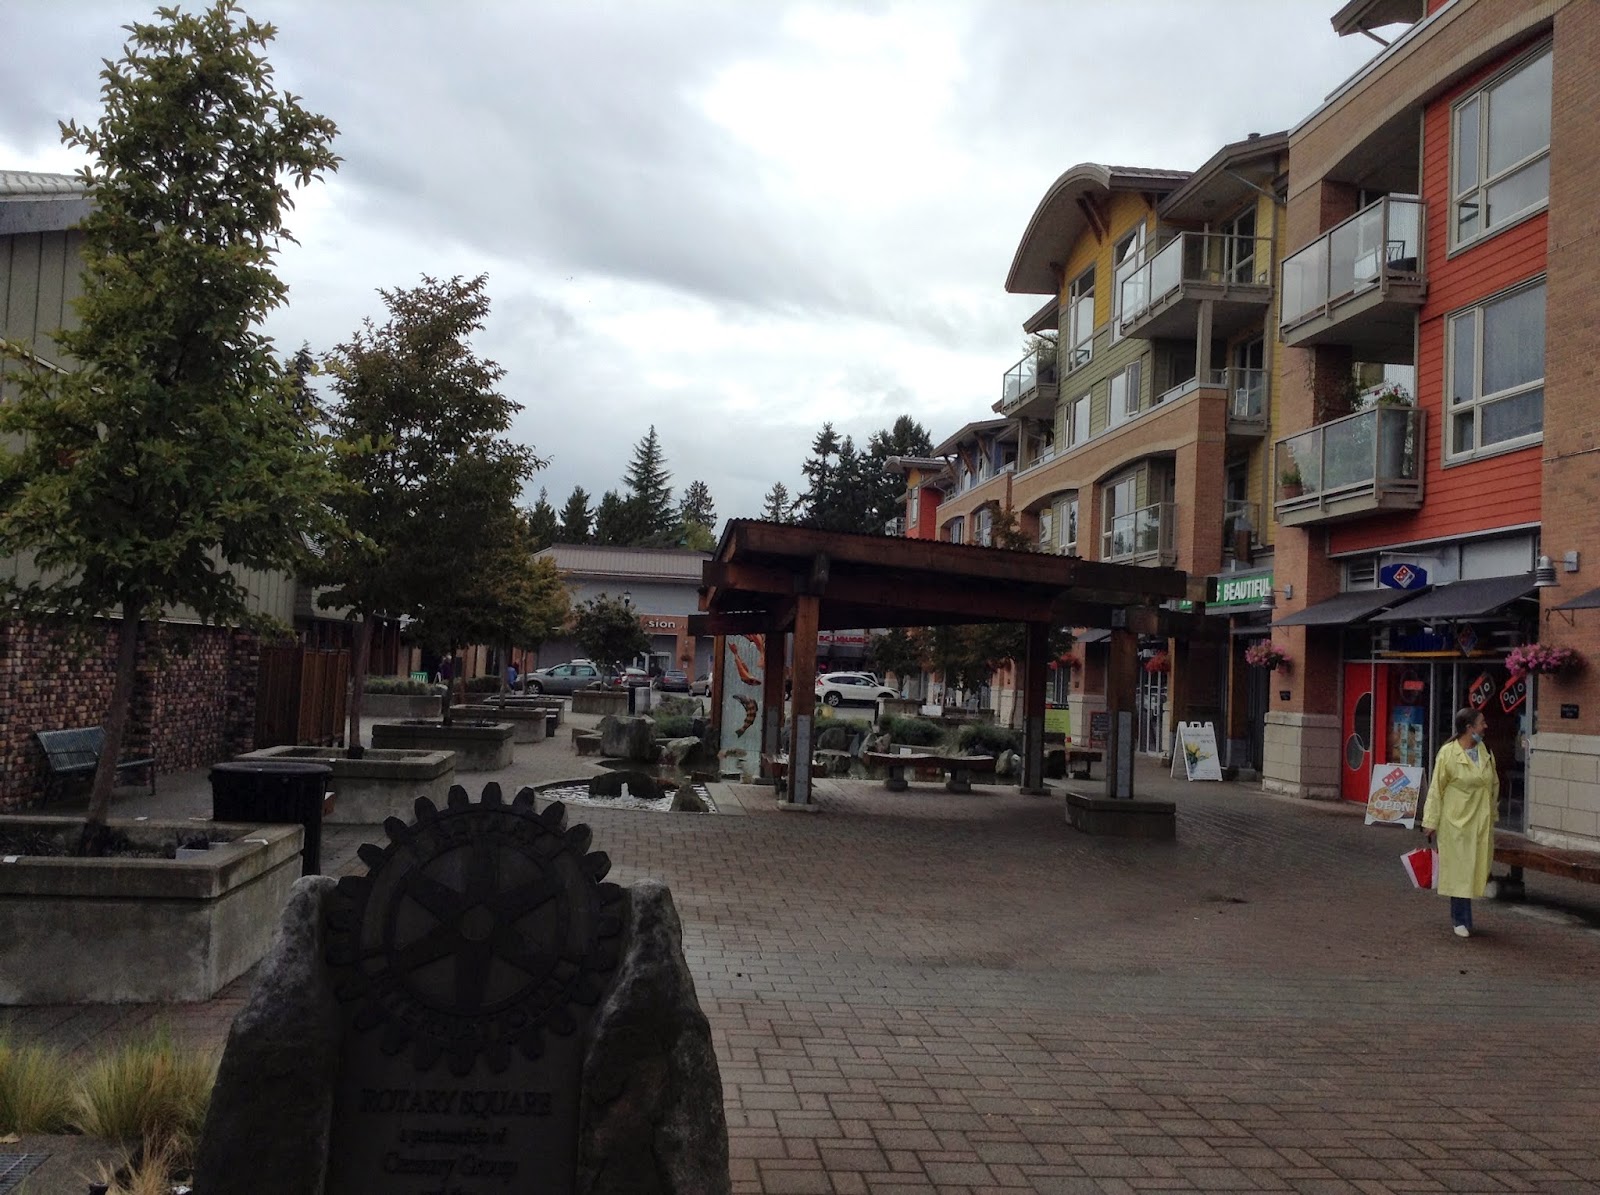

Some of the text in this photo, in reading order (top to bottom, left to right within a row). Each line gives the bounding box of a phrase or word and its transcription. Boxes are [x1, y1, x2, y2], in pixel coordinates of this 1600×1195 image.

[1374, 801, 1411, 813] OPEN
[359, 1088, 553, 1120] ROTARY SQUARE
